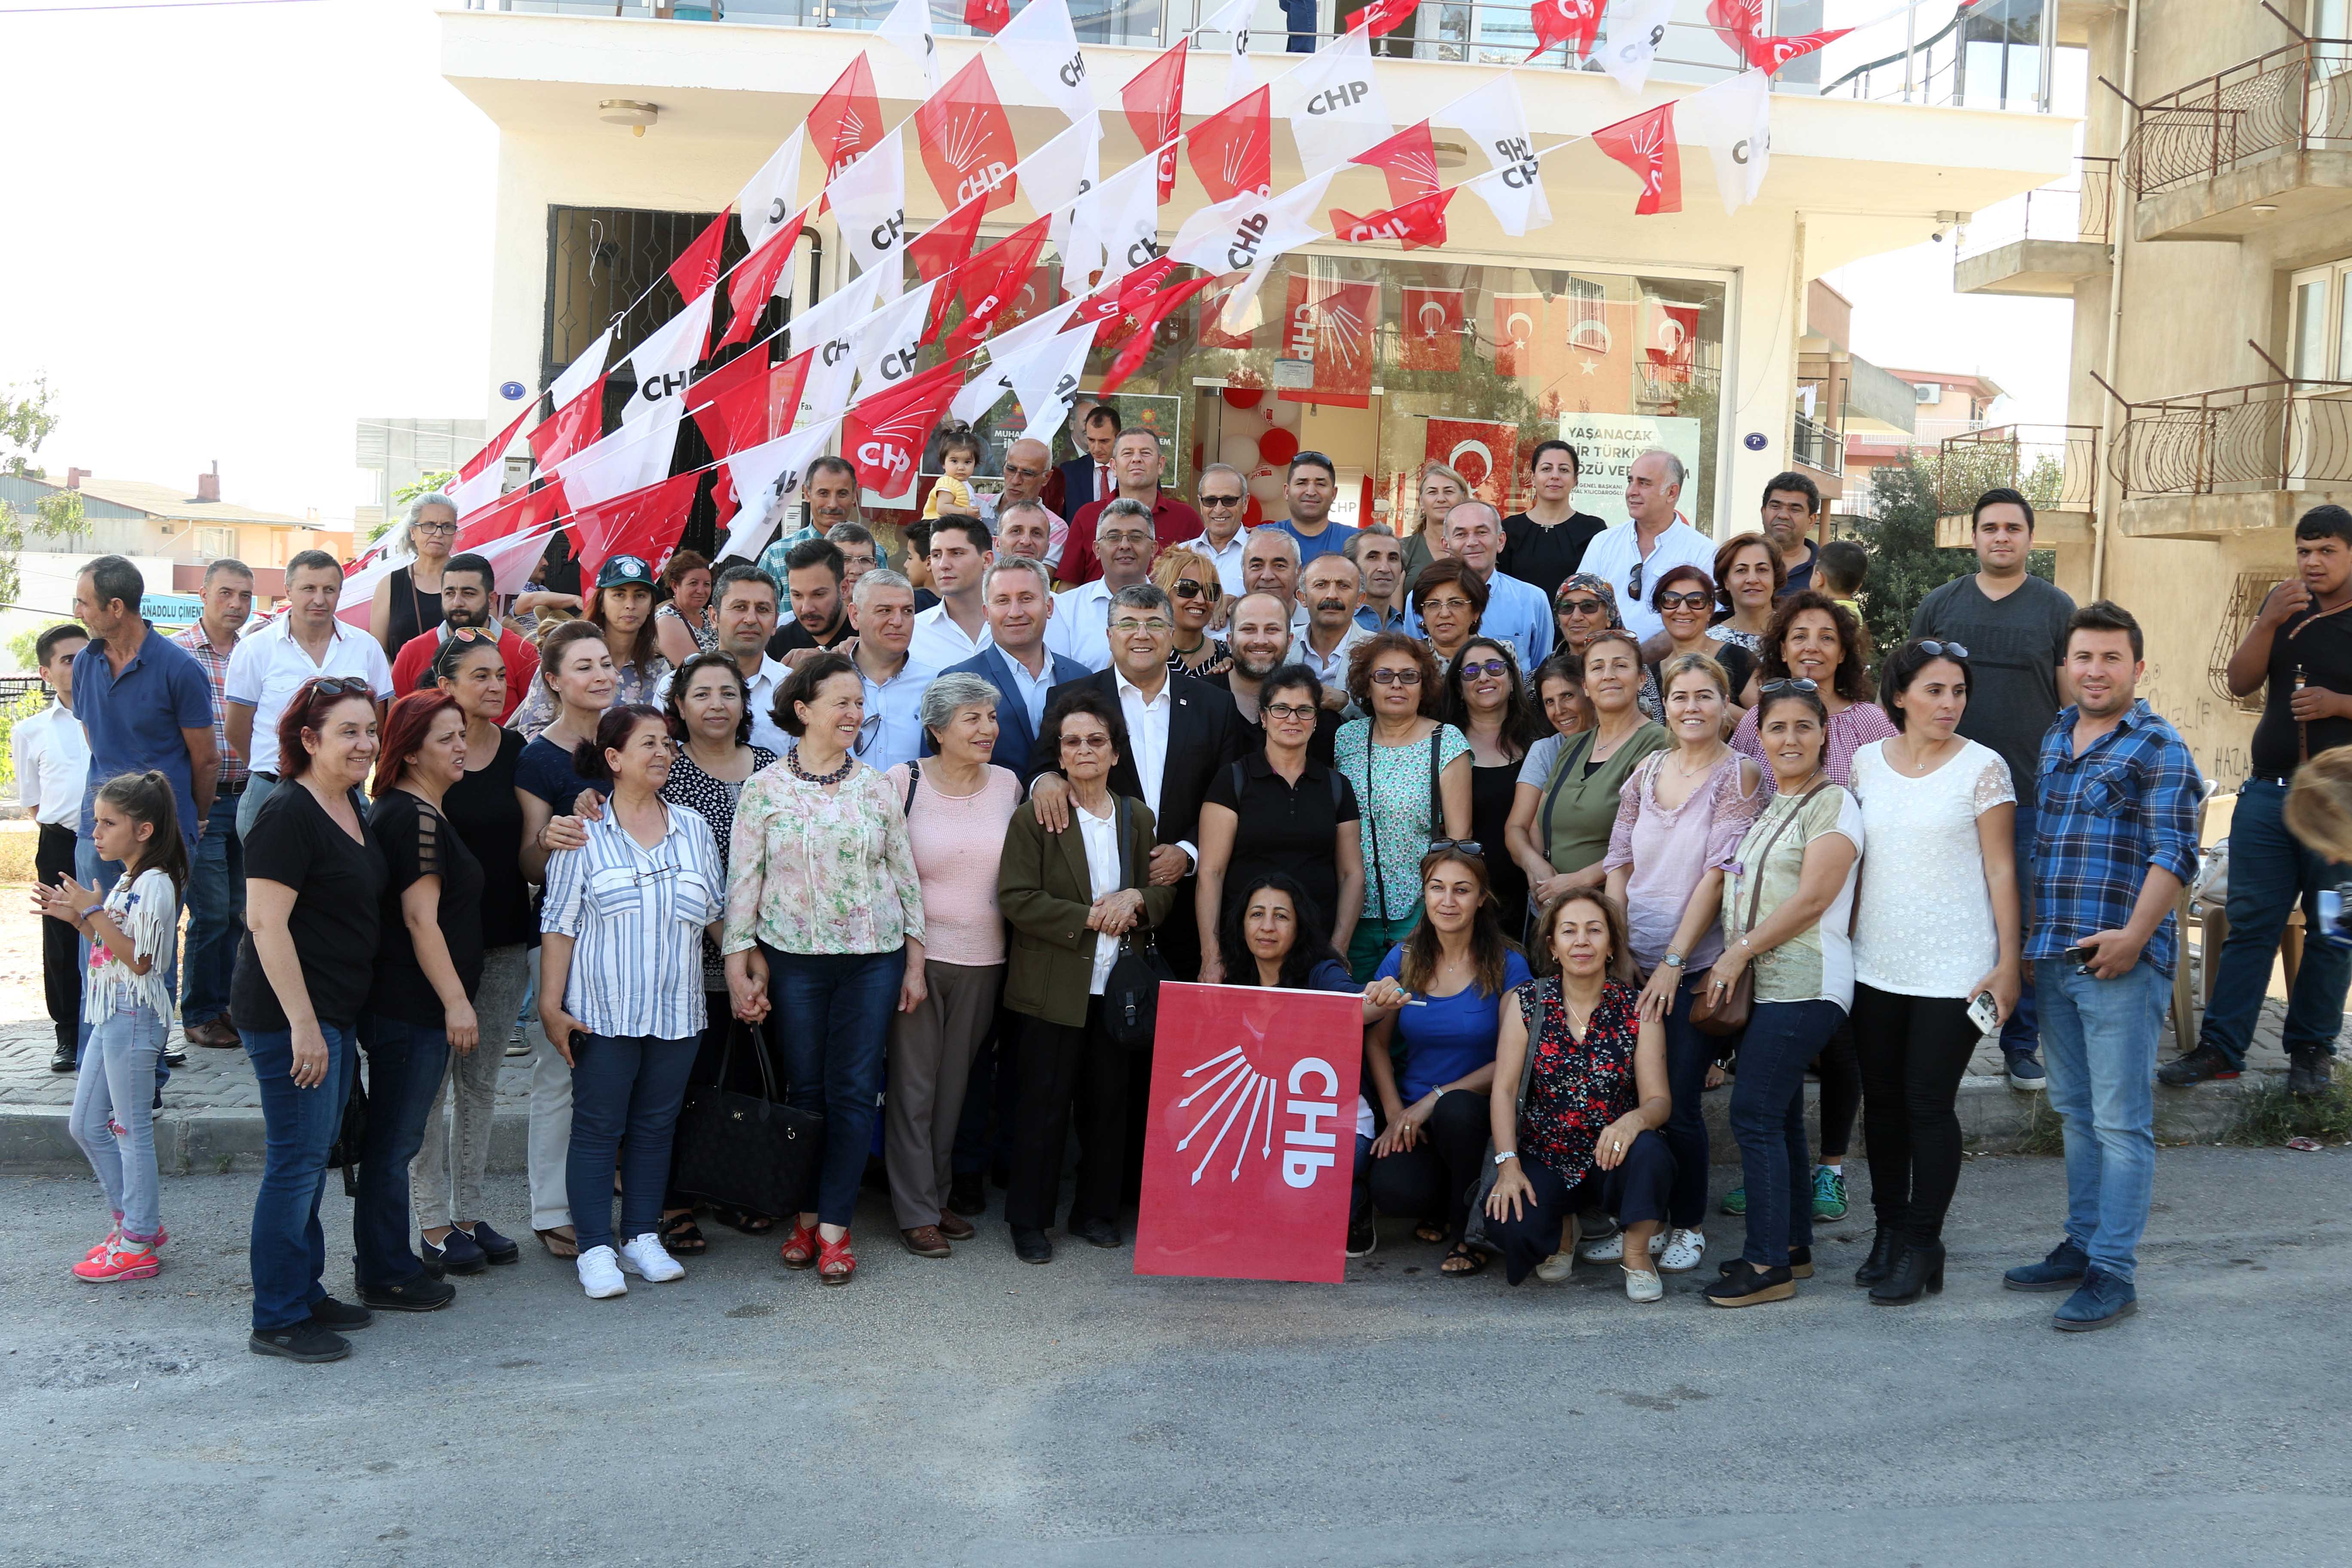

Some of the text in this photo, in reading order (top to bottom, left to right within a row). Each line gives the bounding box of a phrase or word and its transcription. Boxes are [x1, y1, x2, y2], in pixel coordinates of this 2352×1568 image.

[1308, 81, 1368, 115] CHP
[957, 161, 1008, 206] CHP
[1502, 161, 1539, 188] CH
[871, 207, 904, 250] CH
[1127, 230, 1157, 269] CH
[1292, 303, 1317, 361] CHP
[823, 337, 850, 367] CH
[881, 341, 919, 380] CH
[510, 386, 515, 394] 7
[1568, 427, 1653, 441] YAŞANACAK
[1752, 436, 1761, 444] 7A
[858, 442, 911, 477] CHP
[1573, 443, 1649, 458] İR TÜRKİY
[1578, 461, 1604, 475] ÖZÜ
[1331, 502, 1357, 513] CHP
[141, 603, 204, 621] ANADOLU ÇİMENT
[2215, 746, 2252, 784] HAZA
